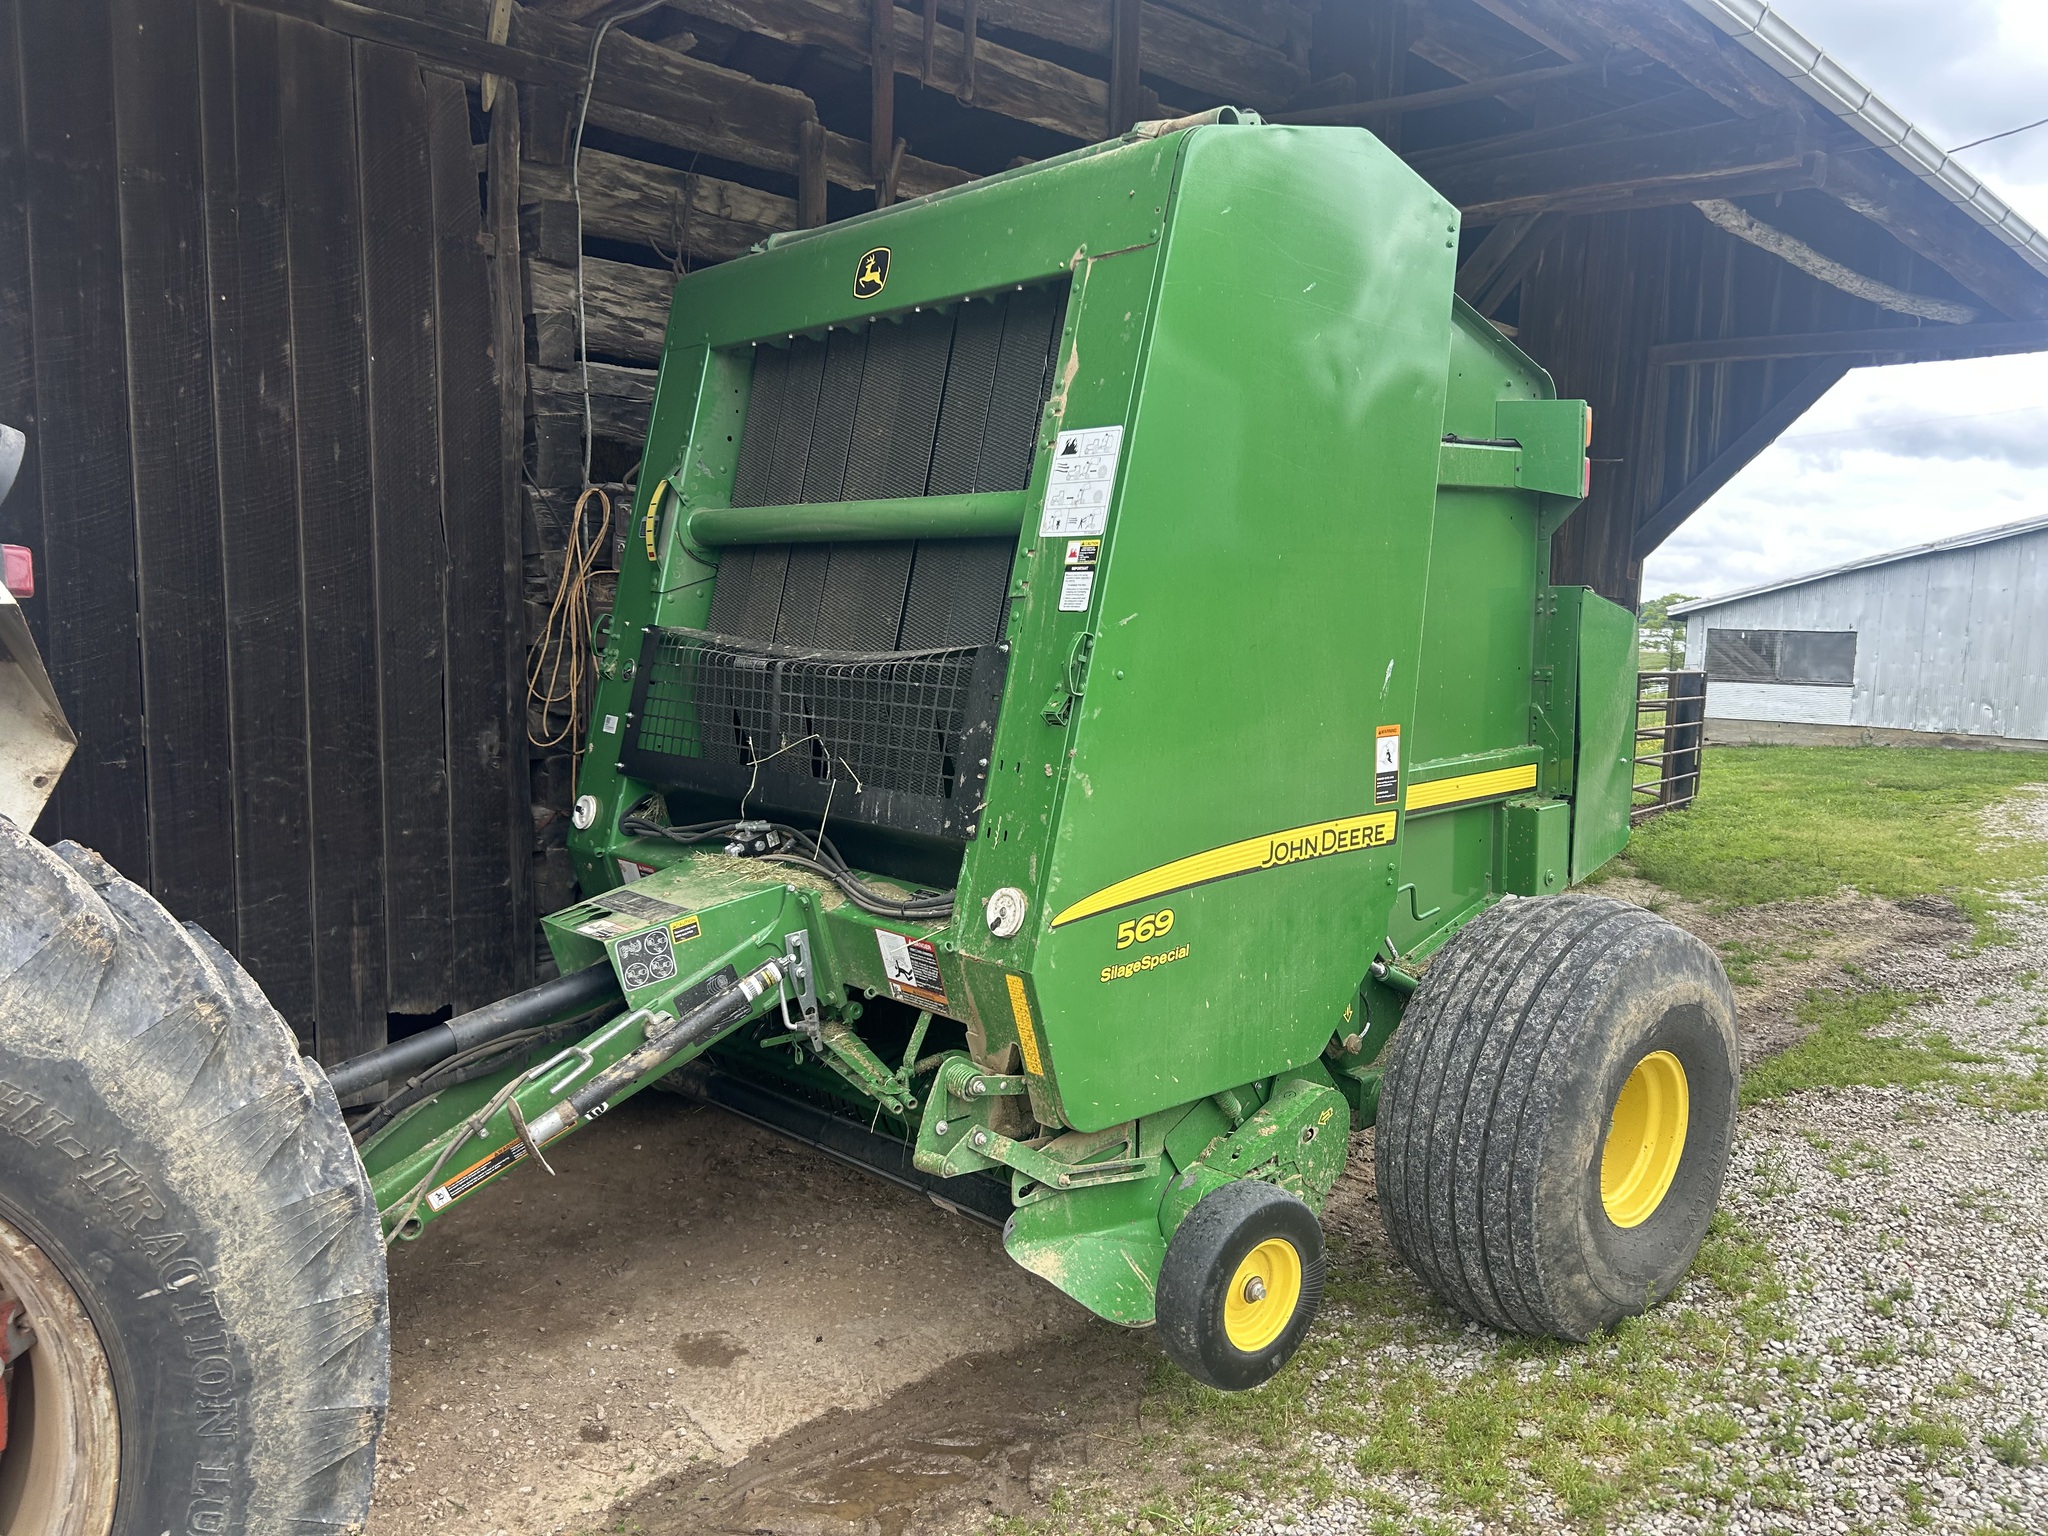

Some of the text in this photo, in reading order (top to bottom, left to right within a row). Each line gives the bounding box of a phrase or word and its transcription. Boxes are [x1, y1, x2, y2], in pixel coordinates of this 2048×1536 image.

[1262, 823, 1387, 865] JOHN DEERE
[1116, 909, 1175, 950] 569
[1100, 943, 1190, 983] SilageSpecial
